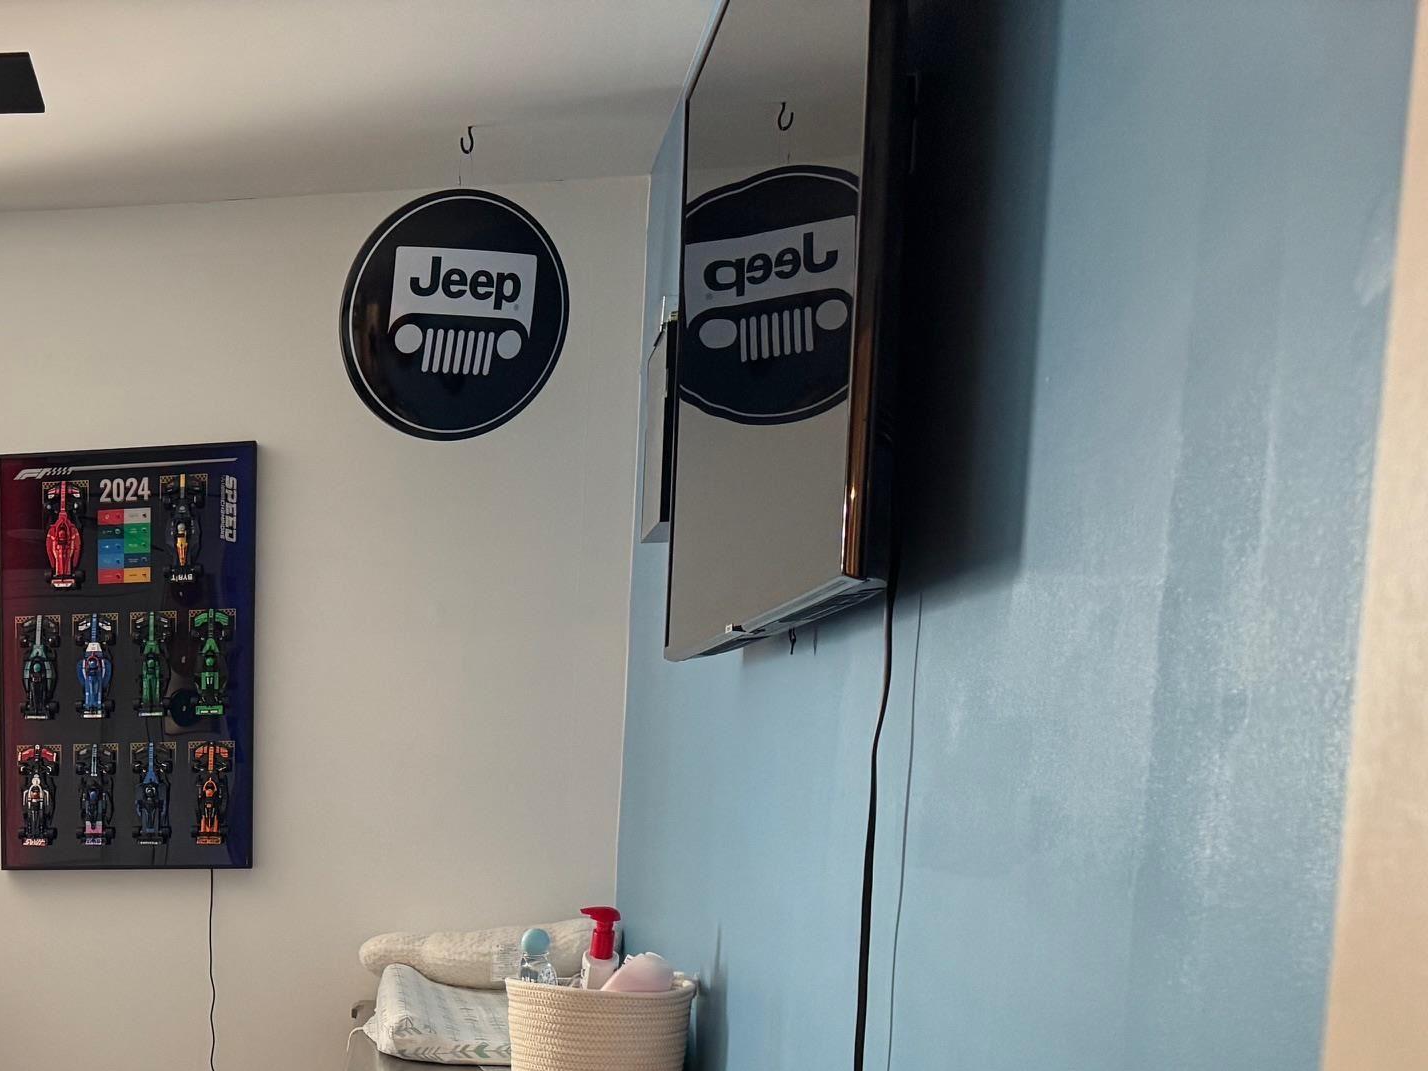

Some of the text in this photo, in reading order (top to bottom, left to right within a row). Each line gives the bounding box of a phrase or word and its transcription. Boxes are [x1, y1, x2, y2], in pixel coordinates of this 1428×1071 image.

[409, 256, 522, 310] Jeep
[100, 477, 151, 503] 2024
[225, 475, 237, 543] SPEED
